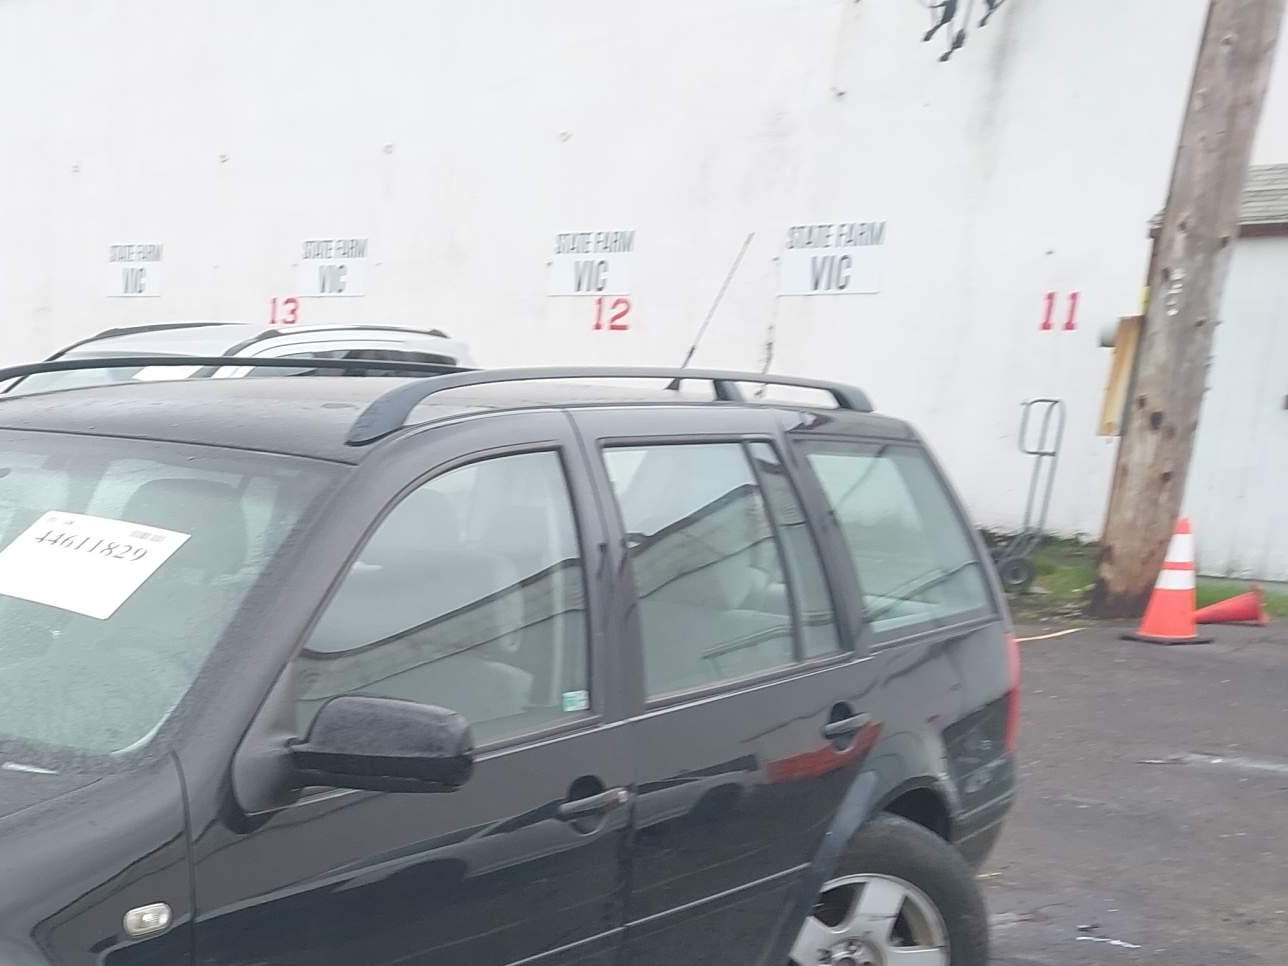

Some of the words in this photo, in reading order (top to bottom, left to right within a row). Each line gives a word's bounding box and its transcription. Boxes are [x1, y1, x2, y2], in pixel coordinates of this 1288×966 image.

[335, 239, 368, 258] FARM
[555, 232, 592, 254] STATE
[593, 231, 634, 253] FARM
[787, 224, 834, 249] STATE
[835, 220, 886, 247] FARM
[121, 267, 145, 293] VIC
[319, 264, 347, 293] VIC
[574, 259, 608, 292] VIC
[810, 254, 852, 291] VIC
[269, 296, 298, 324] 13
[593, 296, 631, 331] 12
[1039, 291, 1080, 331] 11
[35, 529, 148, 562] 44611829
